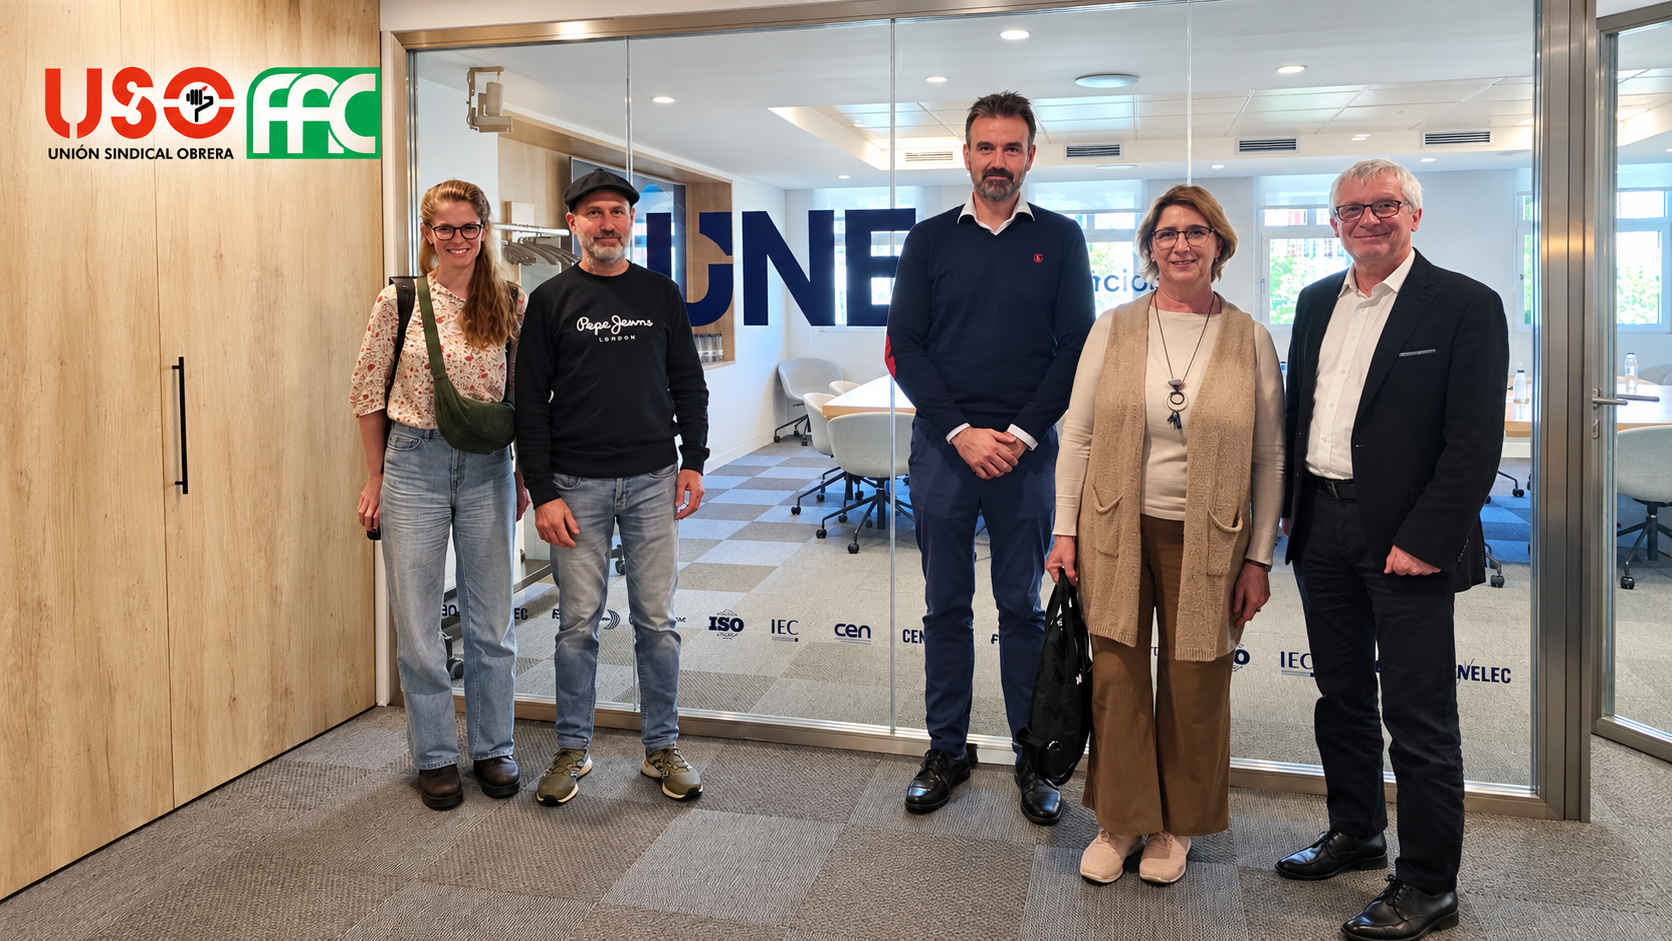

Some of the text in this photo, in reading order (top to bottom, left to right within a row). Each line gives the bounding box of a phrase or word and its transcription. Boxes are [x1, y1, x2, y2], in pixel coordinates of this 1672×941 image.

[646, 208, 916, 327] UNE
[576, 316, 611, 336] Pepe
[708, 616, 745, 633] ISO
[771, 618, 799, 636] IEC
[834, 623, 871, 639] cen
[1280, 651, 1314, 670] IEC
[1456, 664, 1512, 684] NELEC
